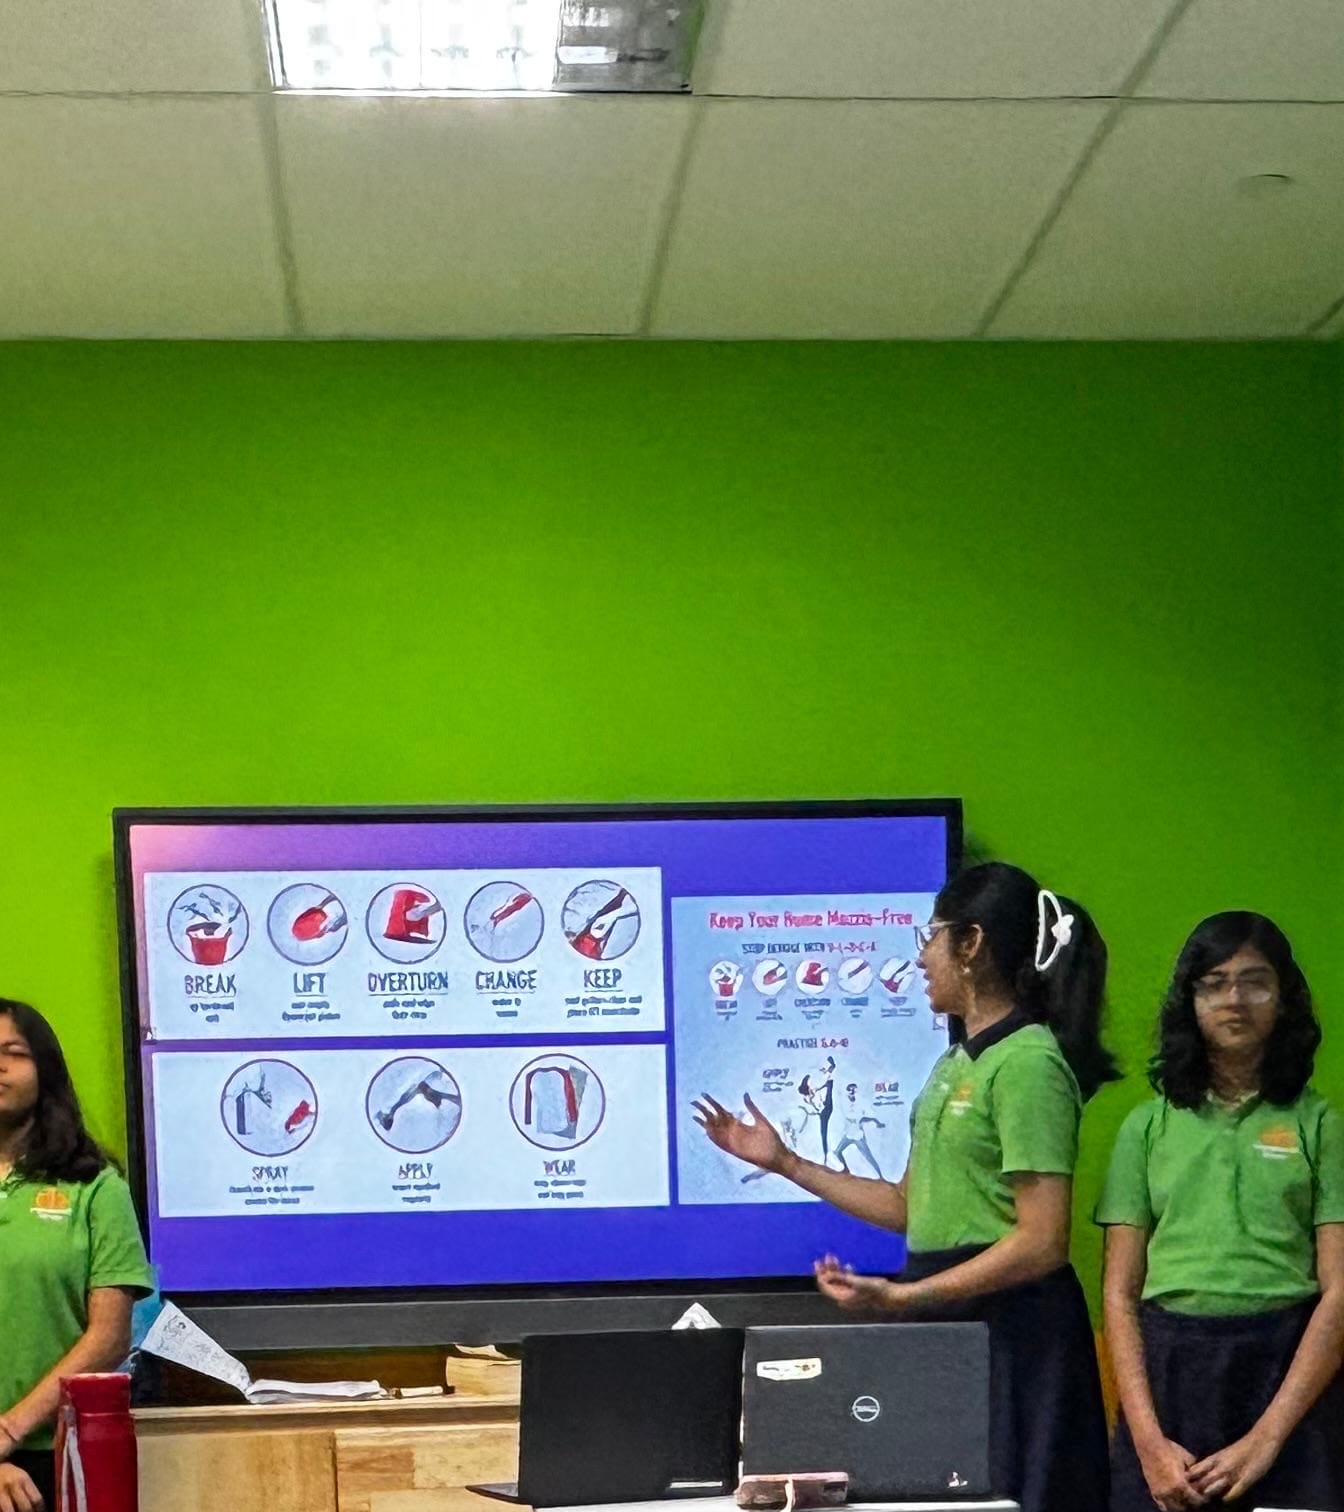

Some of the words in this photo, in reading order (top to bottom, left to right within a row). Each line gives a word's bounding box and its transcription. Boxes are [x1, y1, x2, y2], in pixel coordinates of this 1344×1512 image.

[184, 973, 237, 995] BREAK
[293, 972, 327, 994] LIFT
[367, 969, 449, 992] OVERTURN
[475, 969, 537, 991] CHANGE
[583, 968, 623, 989] KEEP
